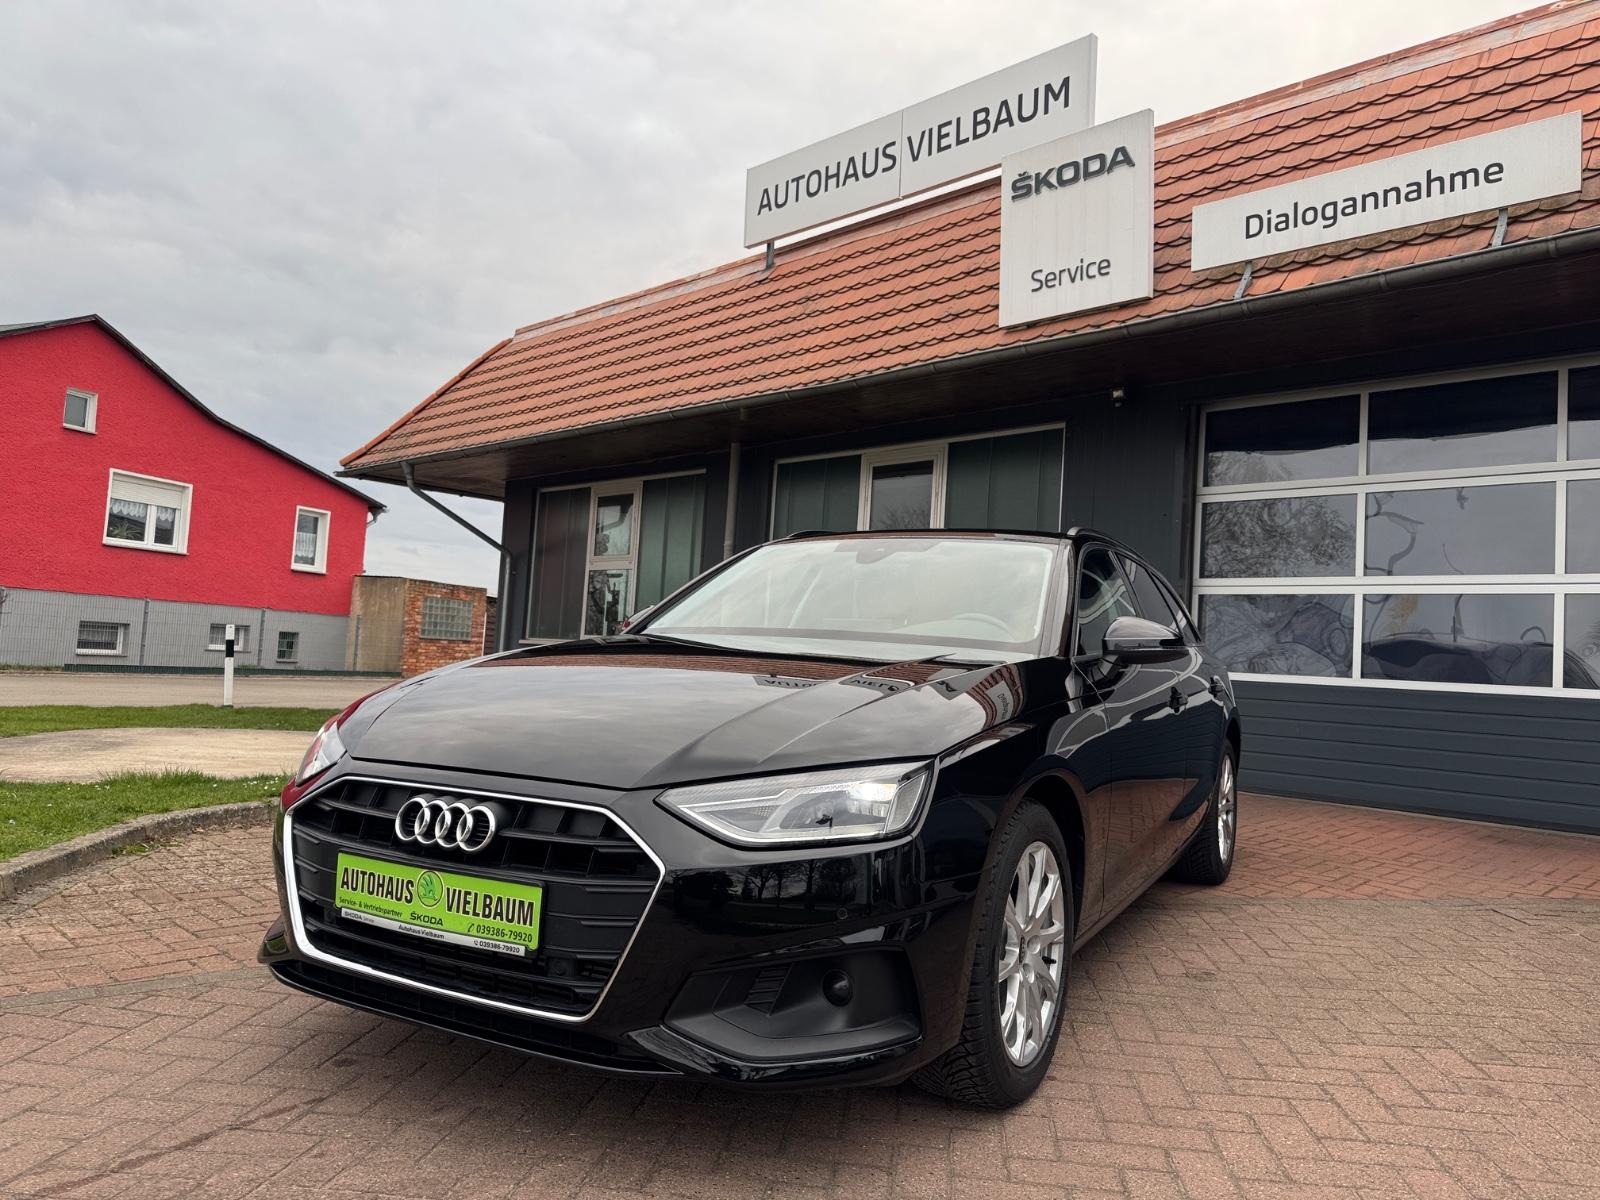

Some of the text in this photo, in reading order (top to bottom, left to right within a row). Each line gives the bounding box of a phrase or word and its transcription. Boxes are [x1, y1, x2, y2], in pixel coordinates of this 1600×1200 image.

[757, 75, 1071, 216] AUTOHAUS VIELBAUM
[1011, 144, 1135, 203] ŠKODA
[1244, 161, 1506, 241] Dialogannahme
[1030, 257, 1112, 294] Service
[340, 867, 534, 927] AUTOHAUS VIELBAUM
[410, 911, 444, 926] ŠKODA
[476, 924, 533, 943] 039386-79920
